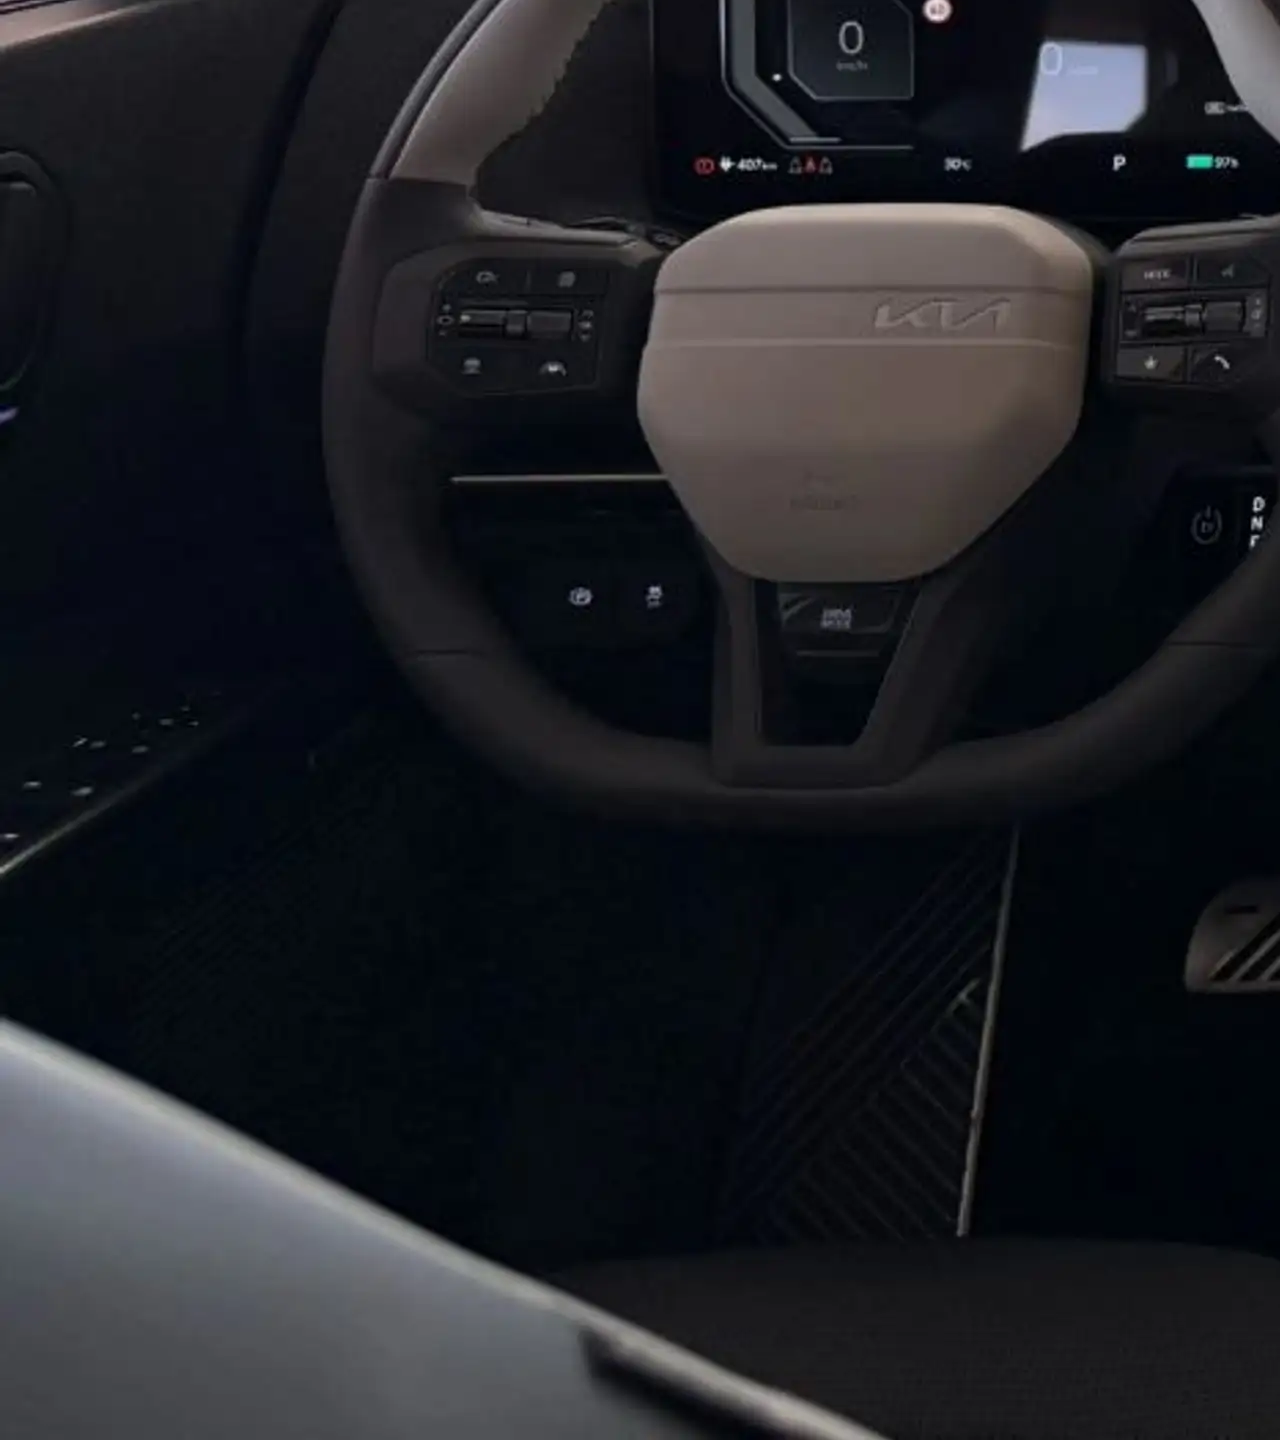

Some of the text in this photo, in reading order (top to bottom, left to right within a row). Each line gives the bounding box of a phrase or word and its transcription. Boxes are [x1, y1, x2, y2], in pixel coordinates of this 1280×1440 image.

[837, 20, 865, 55] 0
[1111, 153, 1128, 172] P
[1251, 495, 1267, 514] D
[1249, 514, 1265, 533] N
